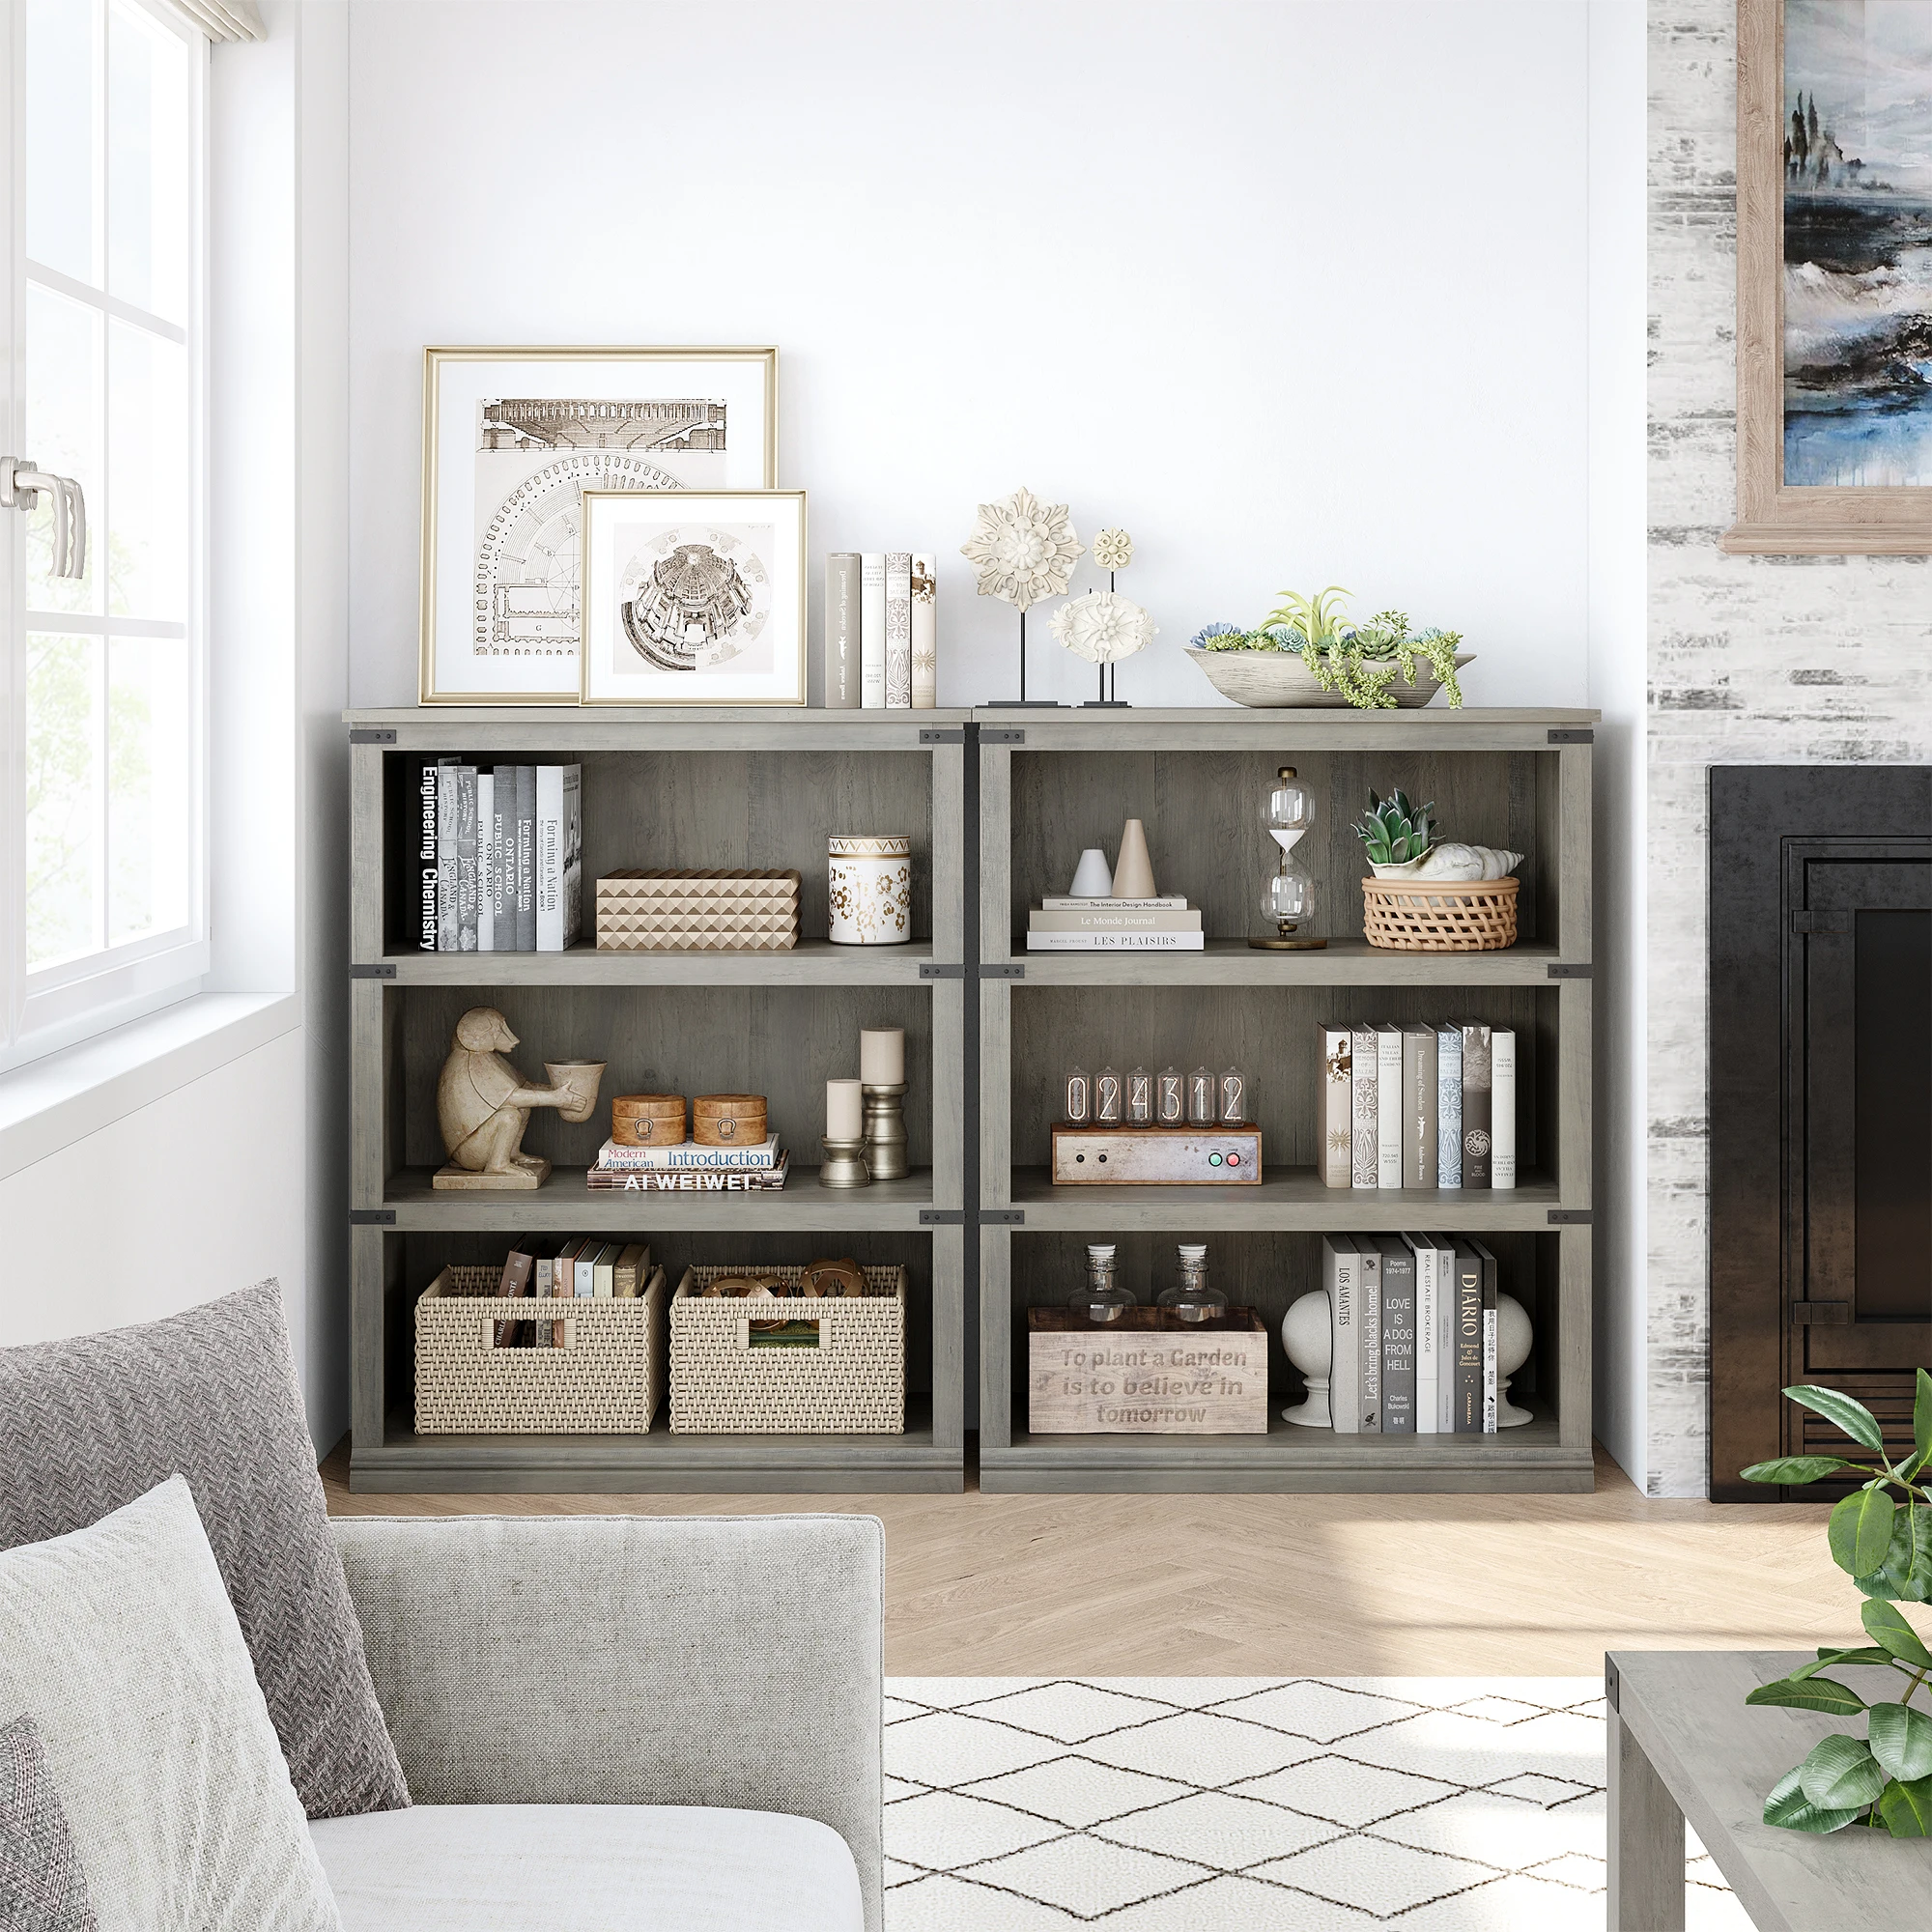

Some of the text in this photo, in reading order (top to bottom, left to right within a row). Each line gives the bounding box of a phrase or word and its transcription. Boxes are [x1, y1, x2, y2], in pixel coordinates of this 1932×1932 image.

[465, 780, 475, 835] PUBLIC SCHOOL
[446, 808, 456, 835] SCHOOL
[523, 819, 532, 865] Forming
[545, 819, 557, 865] Forming
[419, 766, 438, 951] Engineering Chemistry
[494, 813, 502, 917] PUBLIC SCHOOL
[505, 838, 515, 895] ONTARIO
[439, 856, 458, 902] ENGLAND
[458, 855, 476, 903] ENGLAND
[523, 875, 532, 912] Nation
[547, 876, 557, 912] Nation
[1081, 917, 1156, 926] Le Monde Journal
[1094, 936, 1116, 946] LES
[1122, 936, 1177, 946] PLAISIRS
[1416, 1050, 1425, 1079] Dreaming
[604, 1158, 654, 1168] American
[608, 1150, 646, 1158] Modern
[668, 1151, 771, 1166] Introduction
[623, 1174, 750, 1191] AI WEIWEI
[1338, 1267, 1350, 1326] LOS AMANTES
[1365, 1285, 1378, 1317] home!
[1386, 1298, 1411, 1310] LOVE
[1462, 1273, 1482, 1337] DIÁRIO
[1394, 1314, 1404, 1325] IS
[1365, 1318, 1378, 1349] blacks
[1383, 1328, 1413, 1340] A DOG
[1062, 1347, 1247, 1372] To plant a Garden
[1365, 1349, 1380, 1376] bring
[1385, 1345, 1412, 1355] FROM
[1387, 1360, 1411, 1371] HELL
[1063, 1377, 1243, 1396] is to believe in
[1096, 1404, 1207, 1424] tomorrow
